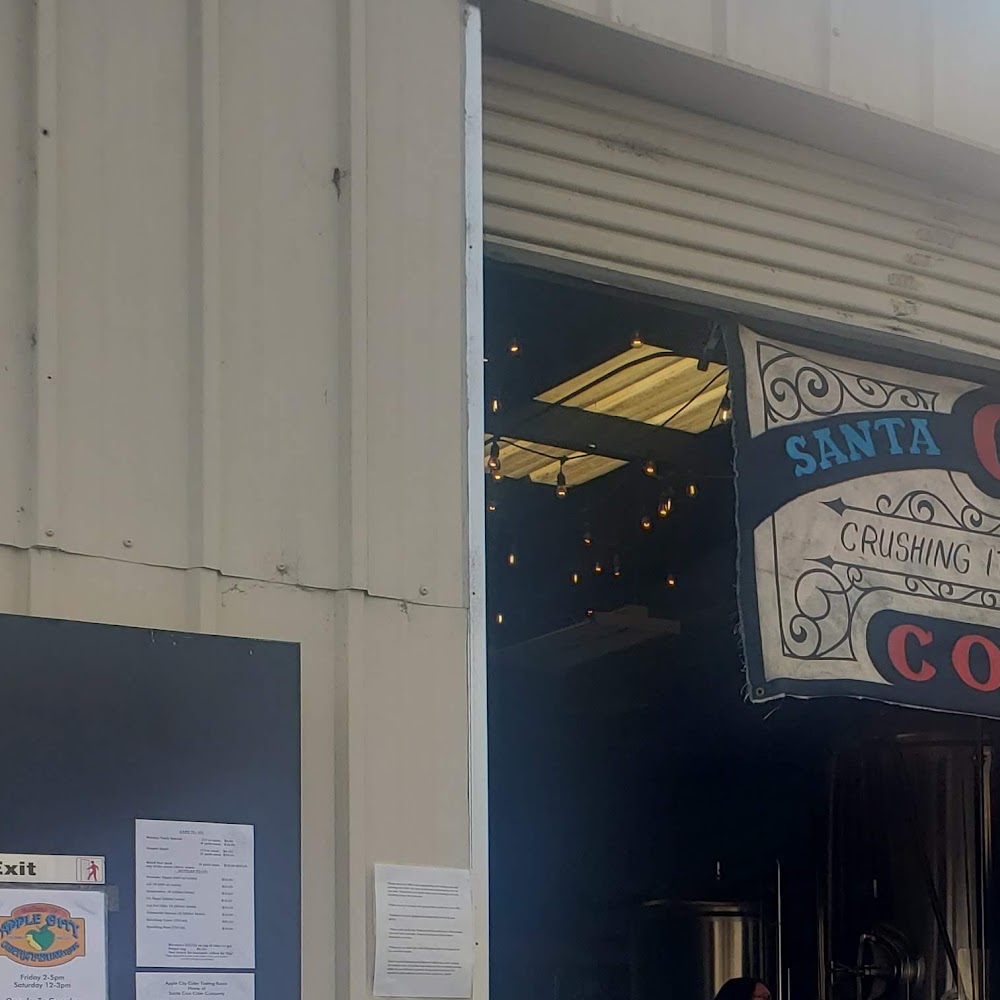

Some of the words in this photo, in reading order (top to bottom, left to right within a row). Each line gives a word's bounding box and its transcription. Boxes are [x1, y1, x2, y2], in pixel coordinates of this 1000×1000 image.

[786, 417, 941, 478] SANTA
[840, 521, 971, 576] CRUSHING
[0, 861, 38, 877] xit
[20, 974, 41, 982] Friday
